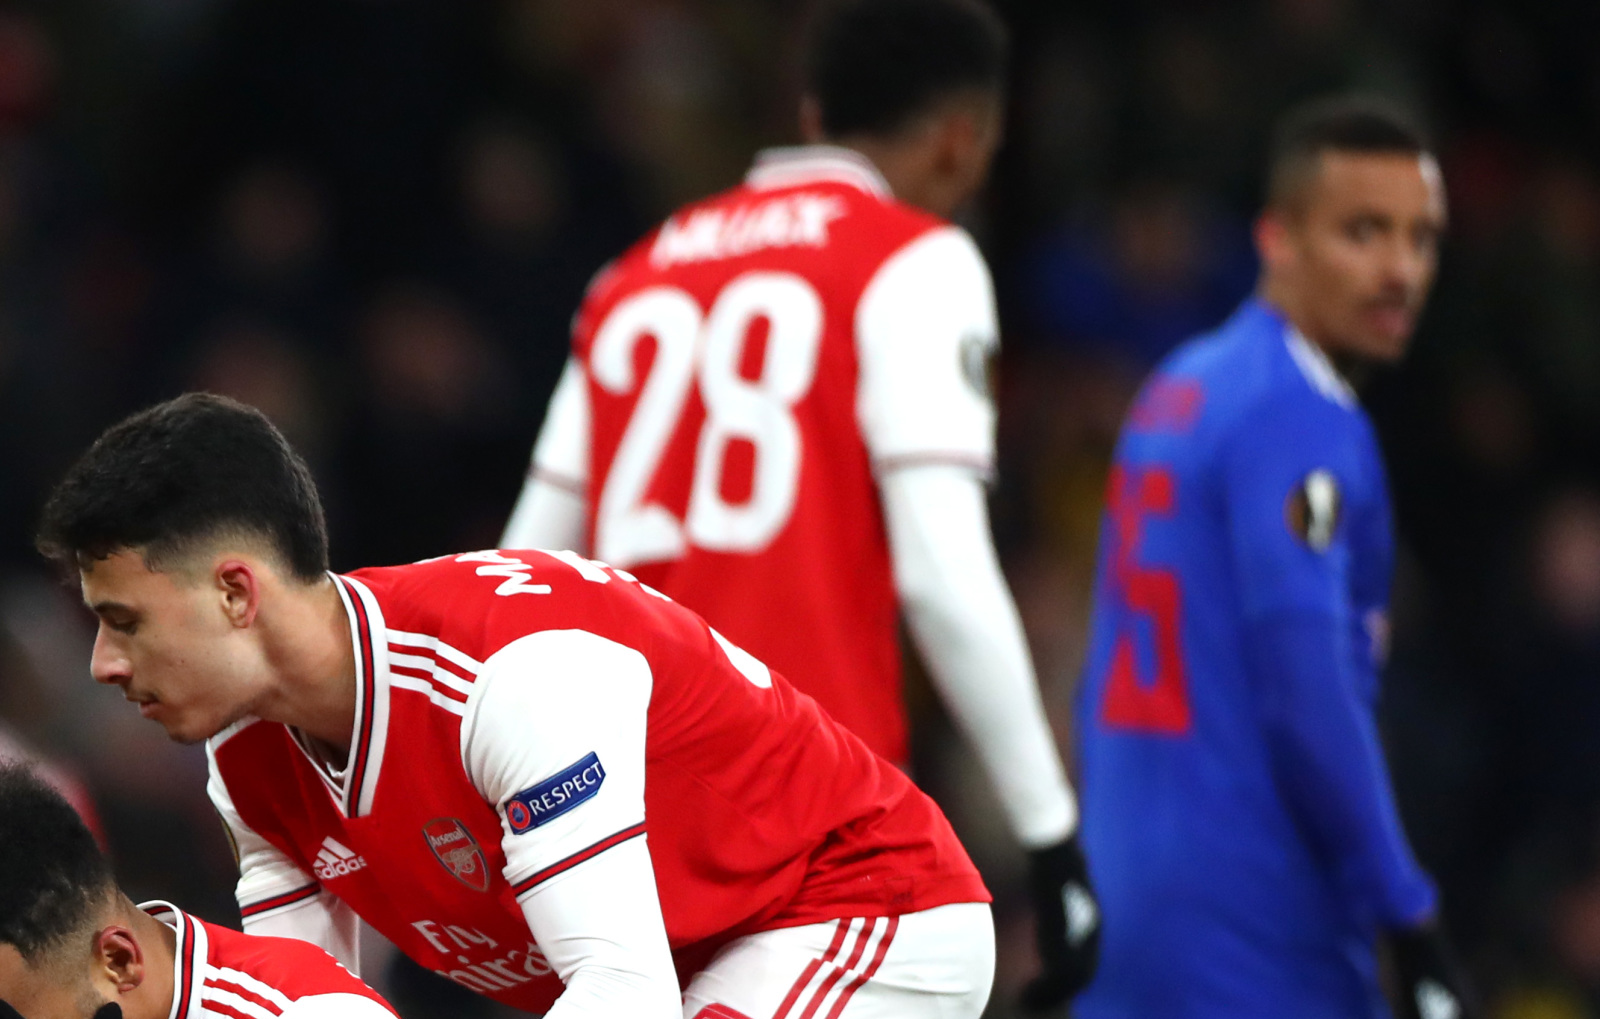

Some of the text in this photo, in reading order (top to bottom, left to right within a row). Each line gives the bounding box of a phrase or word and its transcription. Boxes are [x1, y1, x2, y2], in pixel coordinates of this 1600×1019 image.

[591, 271, 824, 567] 28
[529, 761, 602, 815] RESPECT
[430, 827, 466, 847] Arsenal
[411, 920, 498, 953] Fly
